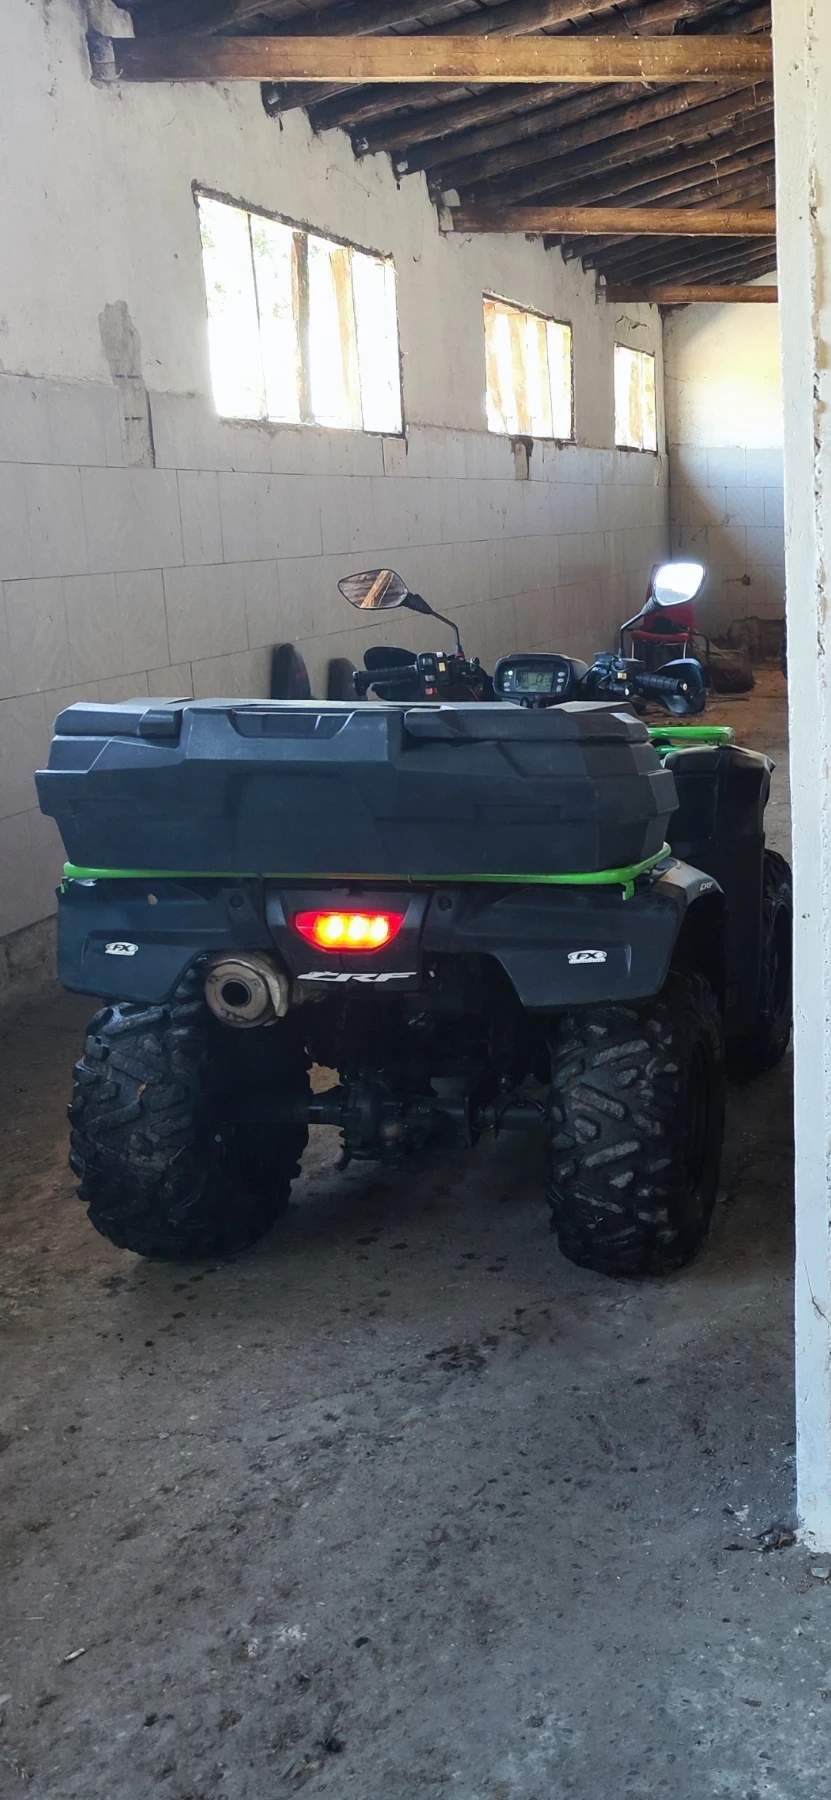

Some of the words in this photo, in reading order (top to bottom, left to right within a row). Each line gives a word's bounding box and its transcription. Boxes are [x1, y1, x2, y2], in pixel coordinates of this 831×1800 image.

[112, 944, 131, 952] FX
[576, 952, 599, 960] FX
[297, 971, 417, 983] CRF
